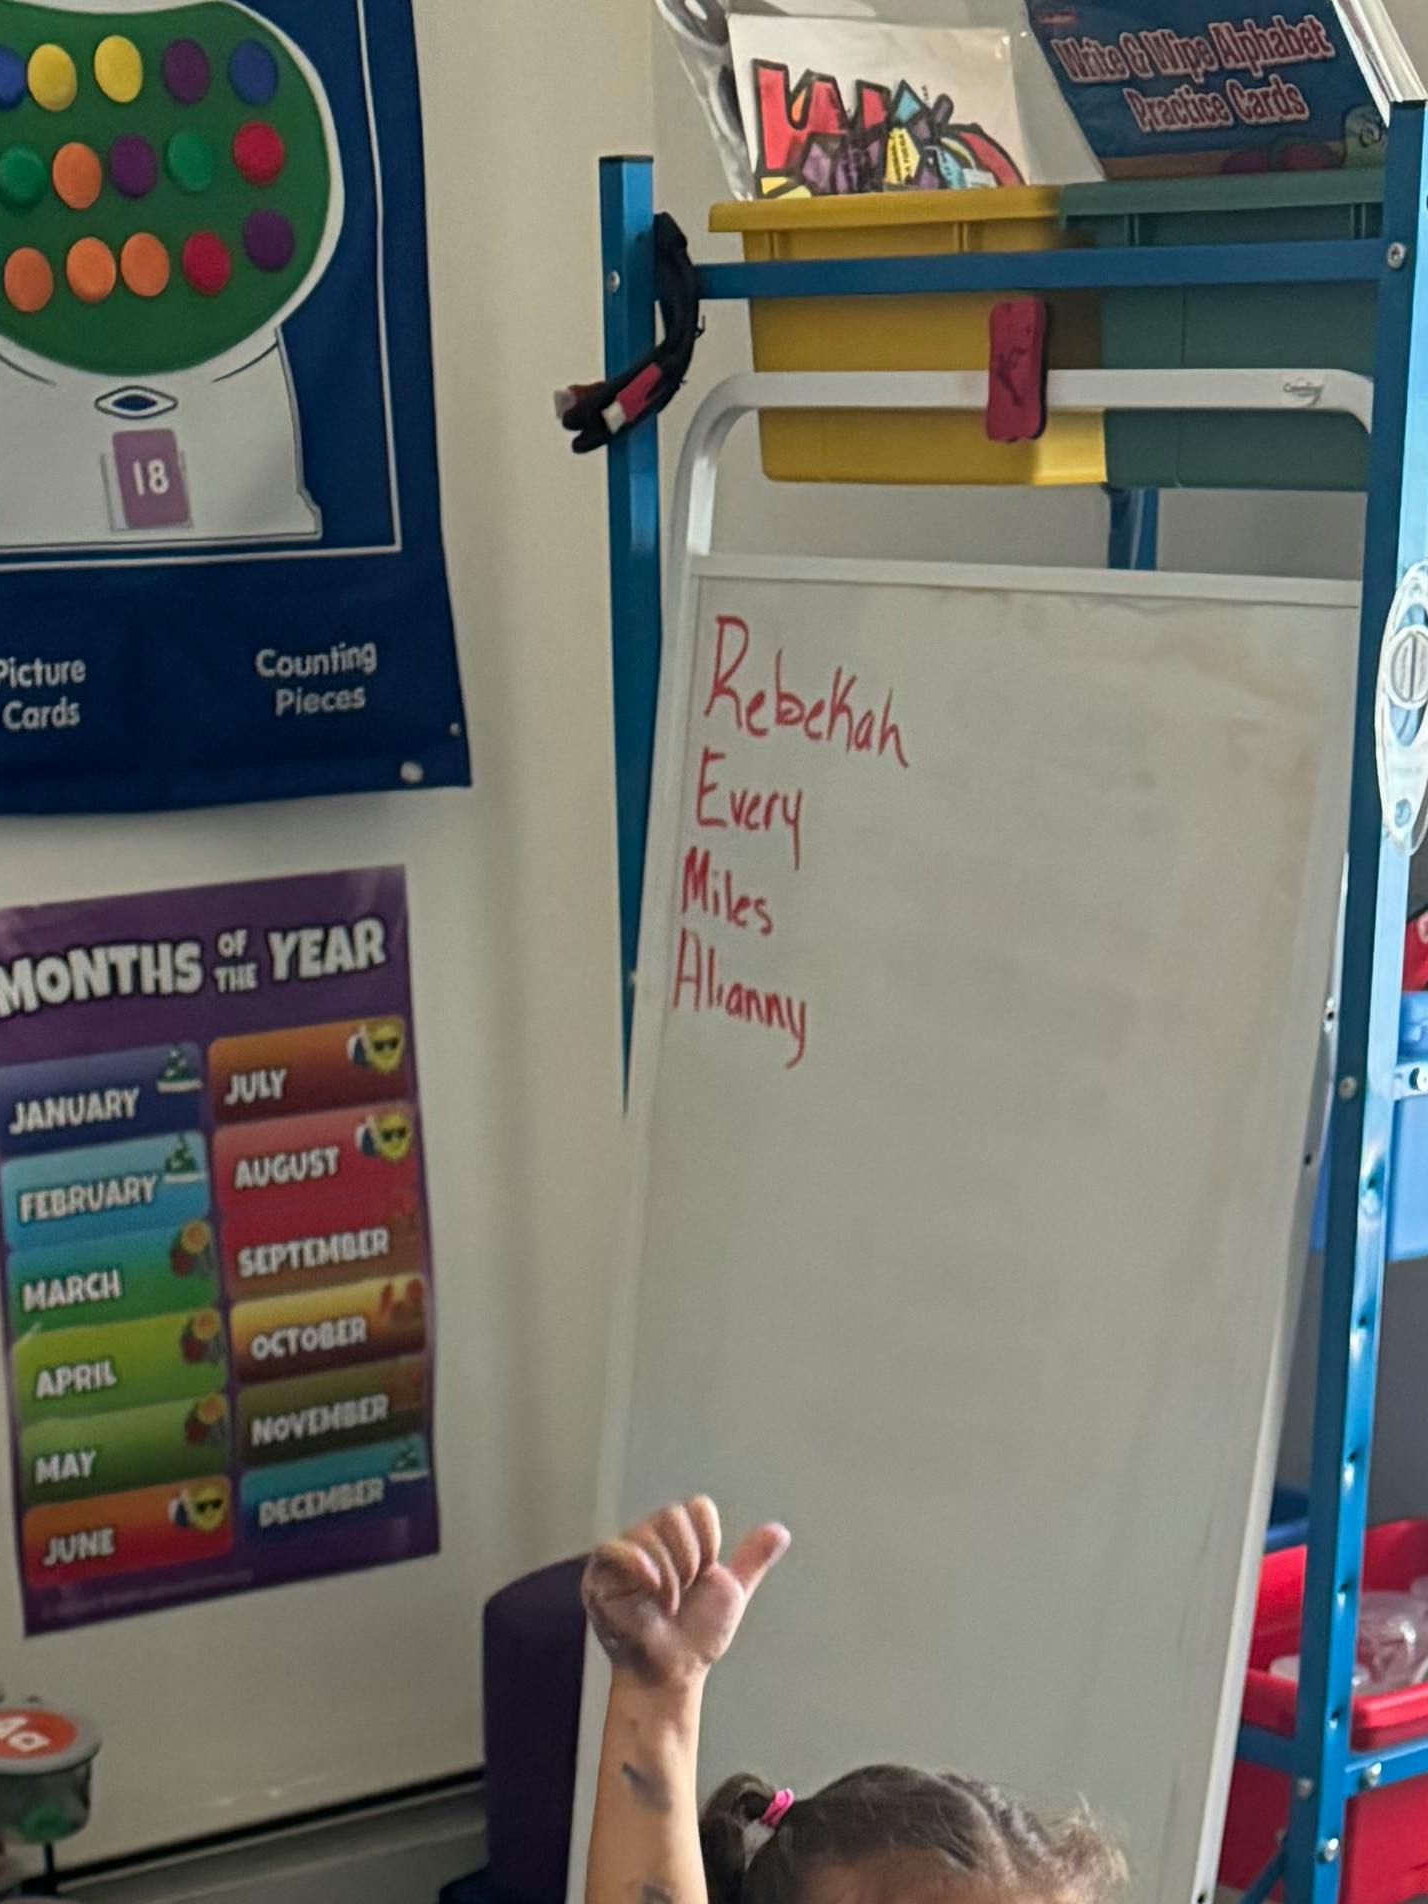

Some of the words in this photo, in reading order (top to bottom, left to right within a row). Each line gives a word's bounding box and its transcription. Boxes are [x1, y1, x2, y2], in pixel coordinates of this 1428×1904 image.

[1052, 37, 1127, 83] Write
[1120, 34, 1152, 76] &
[1146, 29, 1212, 84] Wipe
[1210, 14, 1335, 72] Alphabet
[1124, 77, 1231, 132] Practice
[1232, 73, 1309, 125] Cards
[130, 459, 168, 495] 18
[255, 637, 378, 680] Counting
[2, 697, 81, 733] Cards
[274, 682, 366, 716] Pieces
[696, 746, 803, 871] Every
[682, 846, 774, 935] Miles
[217, 929, 249, 959] OF
[267, 916, 387, 981] YEAR
[214, 960, 258, 995] THE
[224, 1069, 287, 1105] JULY
[8, 1088, 140, 1135] JANUARY
[234, 1146, 340, 1189] AUGUST
[19, 1174, 158, 1223] FEBRUARY
[236, 1228, 390, 1278] SEPTEMBER
[22, 1271, 121, 1312] MARCH
[250, 1319, 367, 1360] OCTOBER
[35, 1360, 116, 1399] APRIL
[250, 1394, 389, 1447] NOVEMBER
[34, 1451, 96, 1484] MAY
[259, 1478, 385, 1529] DECEMBER
[42, 1528, 116, 1567] JUNE
